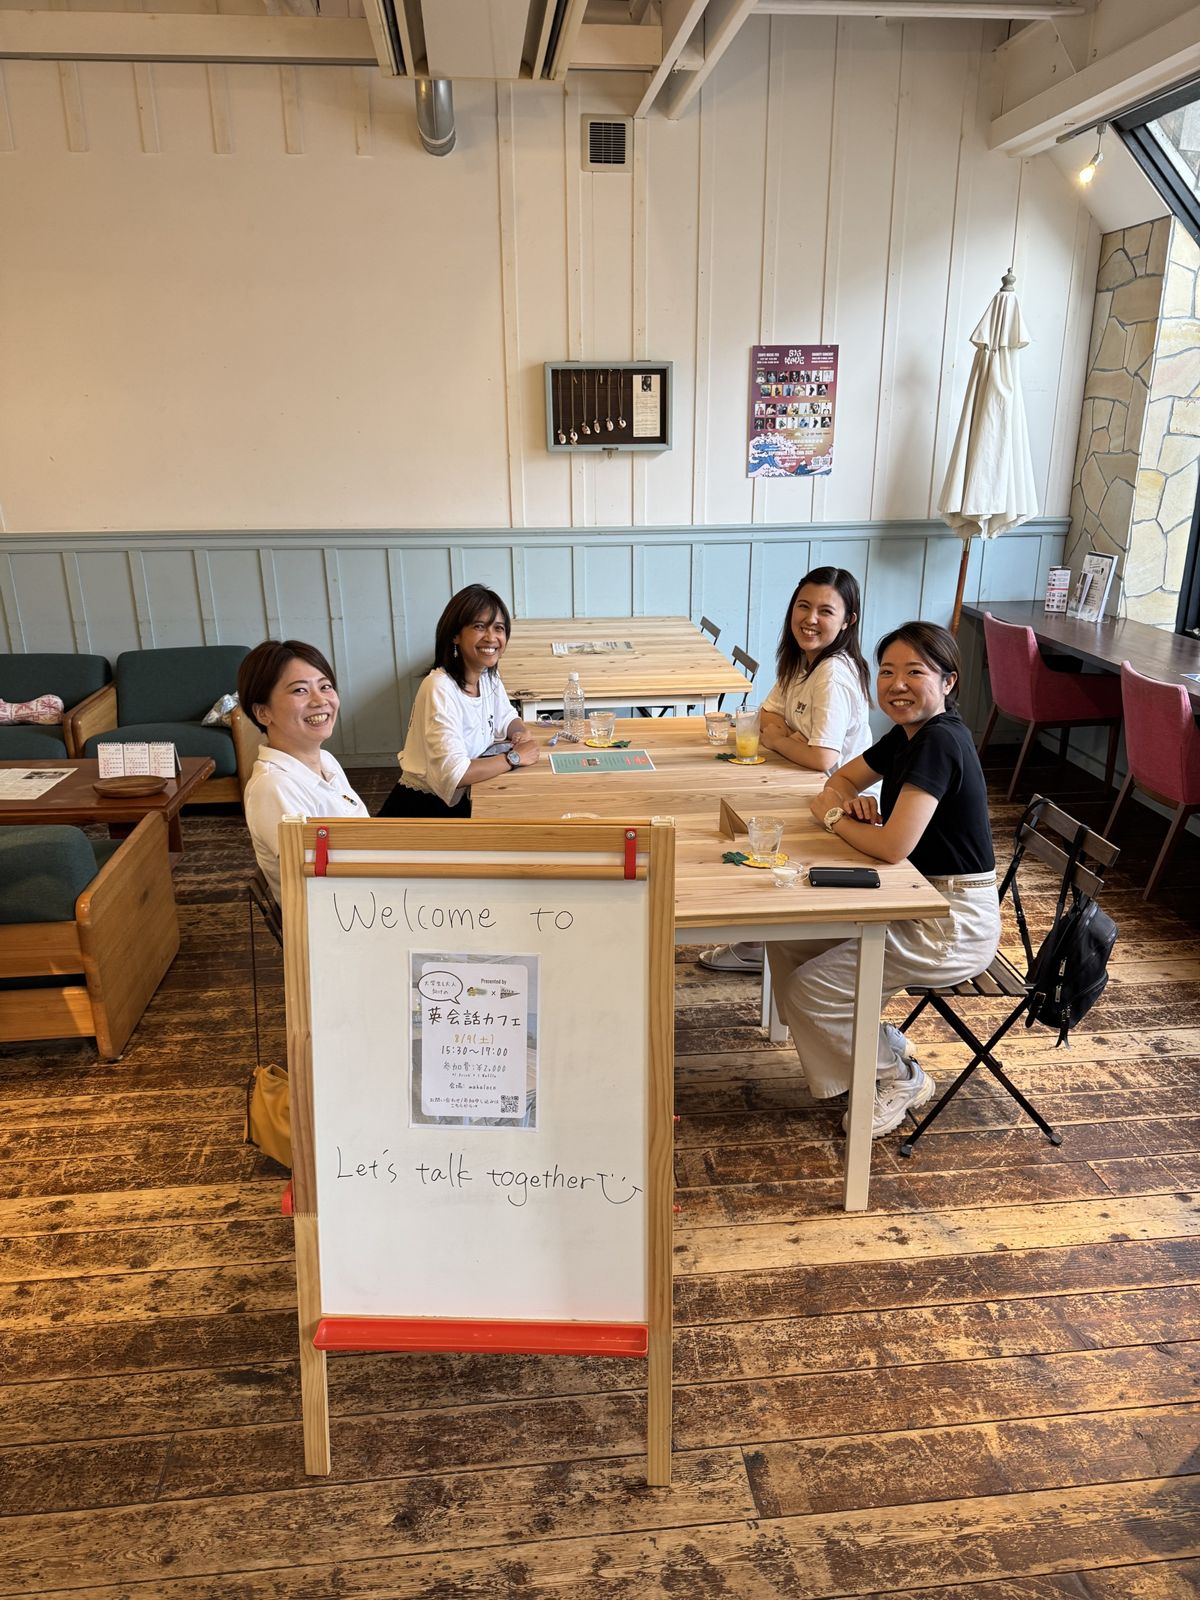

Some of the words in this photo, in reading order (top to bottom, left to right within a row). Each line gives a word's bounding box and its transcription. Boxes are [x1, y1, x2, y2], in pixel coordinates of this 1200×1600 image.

[333, 888, 497, 933] Welcome
[529, 906, 575, 932] to
[428, 1006, 521, 1027] 英会話カフェ
[336, 1146, 399, 1184] Let's
[415, 1152, 473, 1188] talk
[486, 1164, 596, 1207] together
